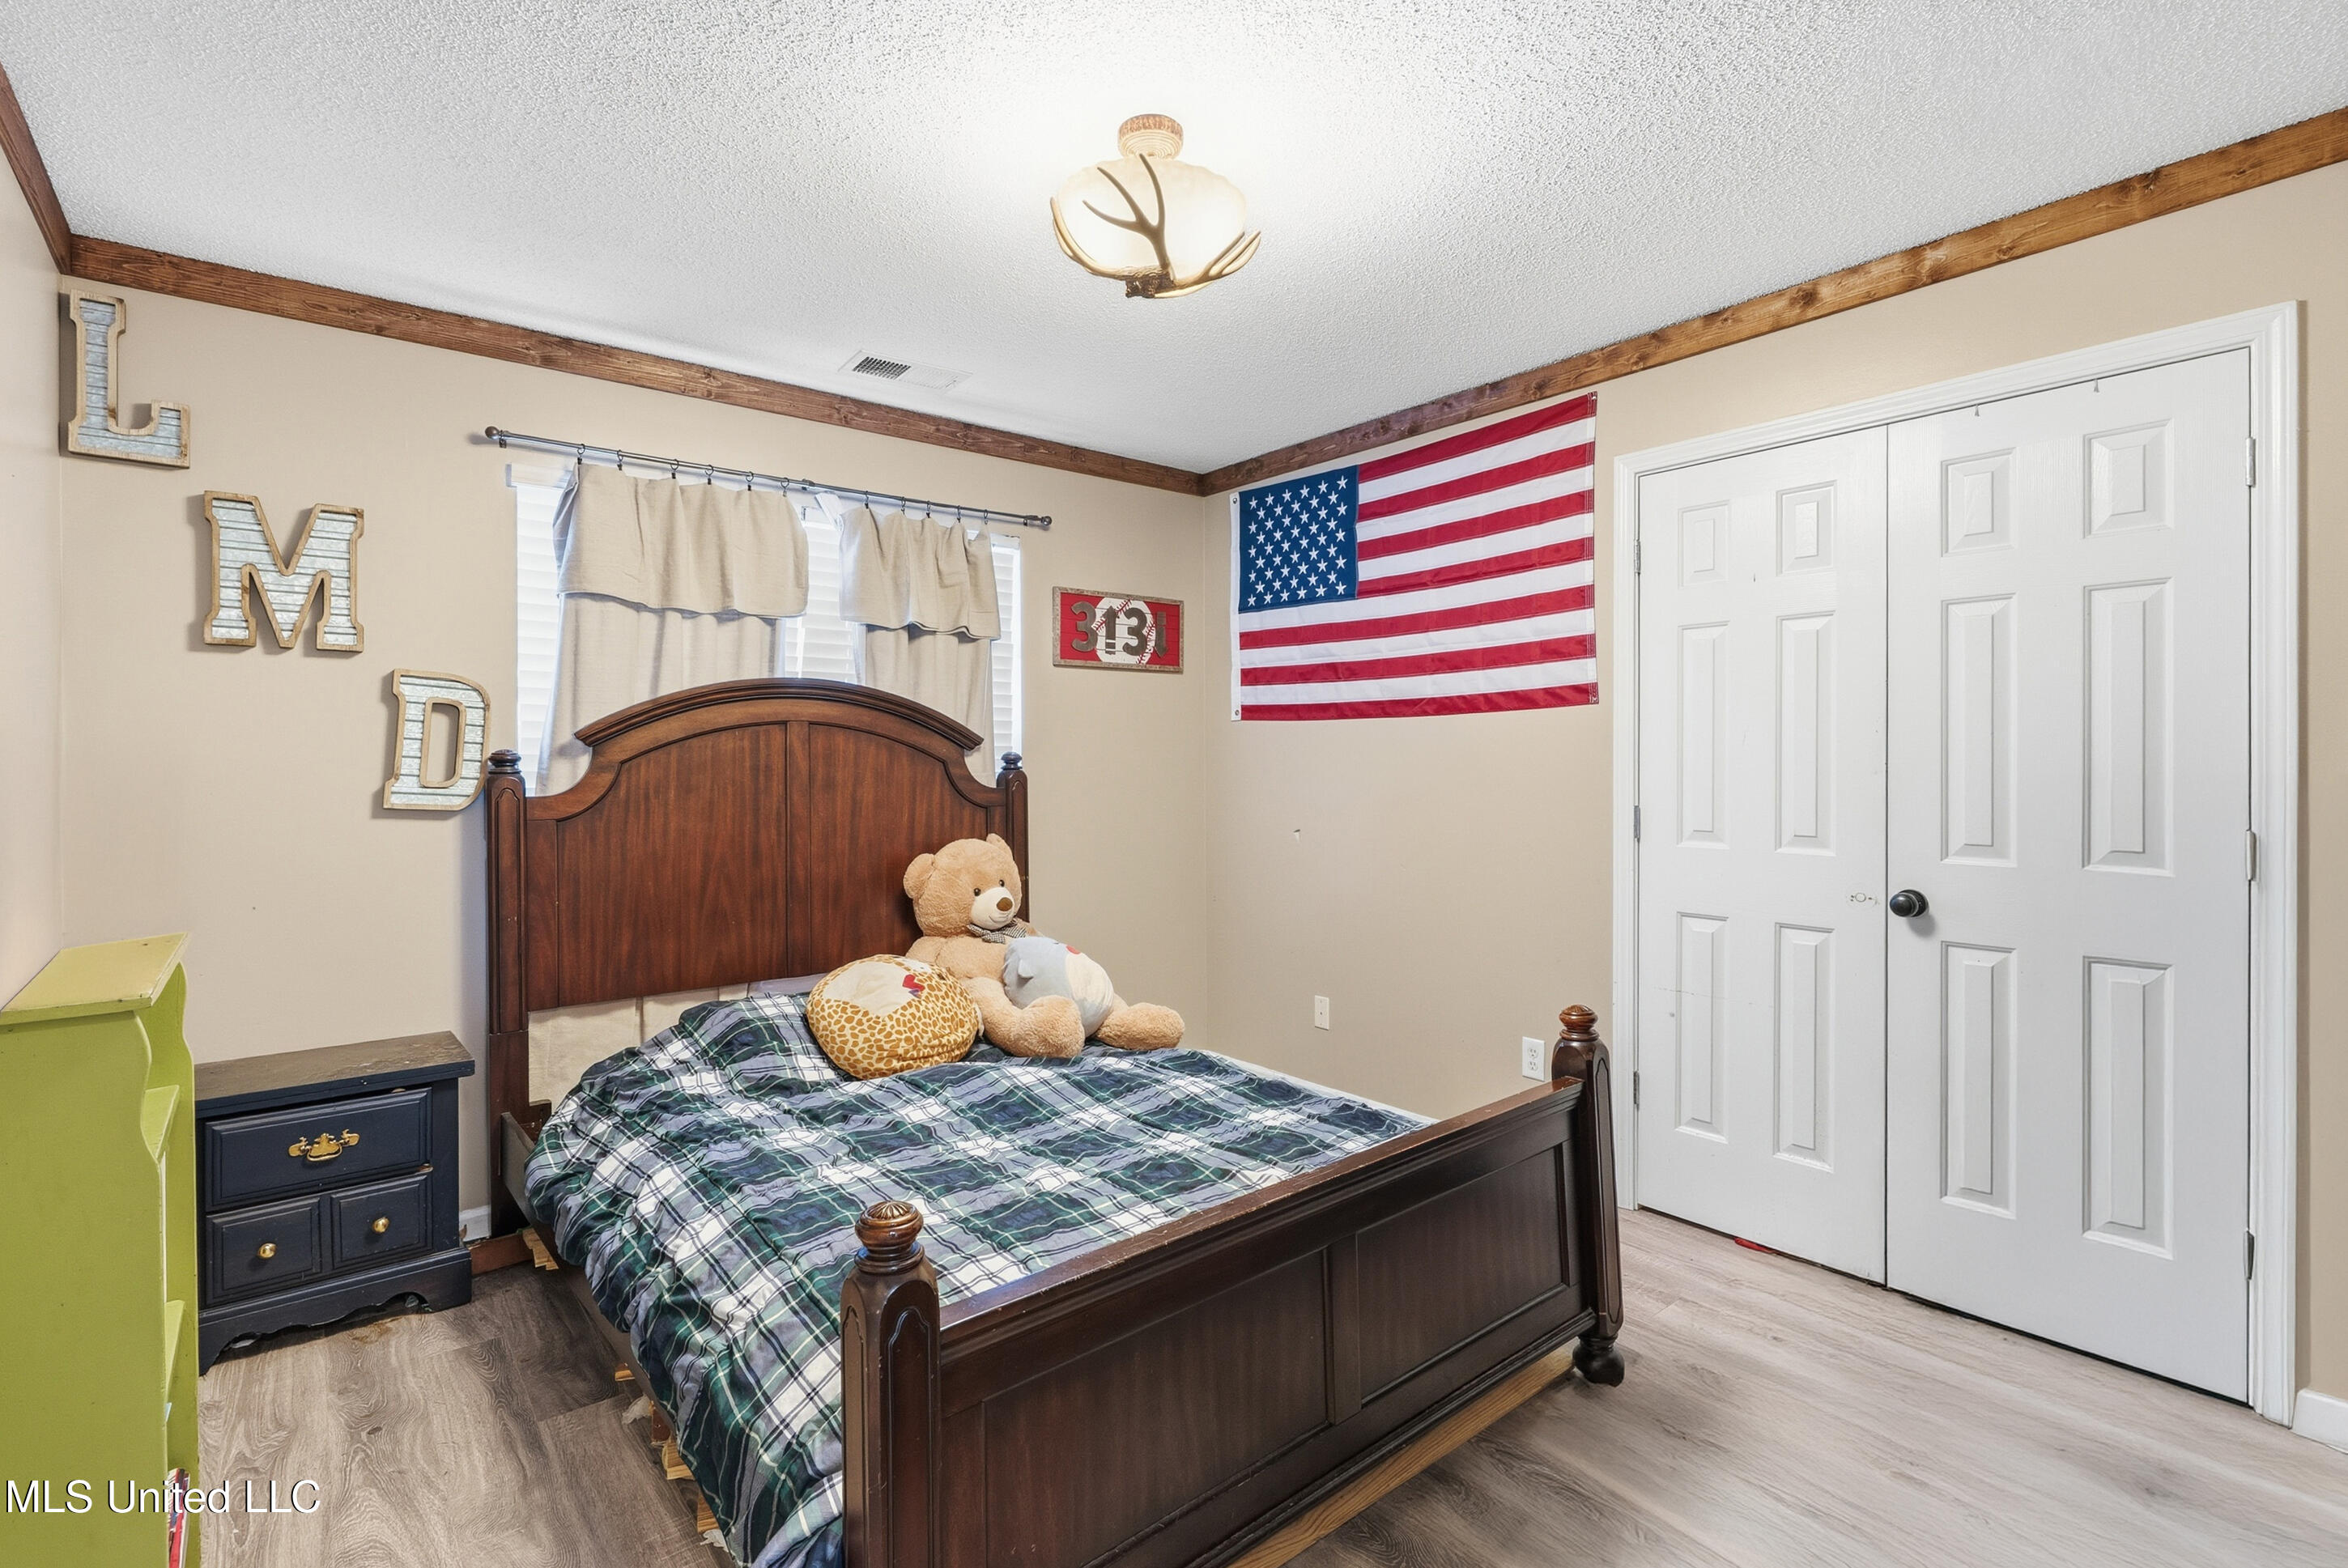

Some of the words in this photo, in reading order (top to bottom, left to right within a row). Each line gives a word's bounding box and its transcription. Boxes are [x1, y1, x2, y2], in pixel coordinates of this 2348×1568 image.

[68, 289, 190, 468] L
[204, 490, 364, 652] M
[383, 668, 491, 810] D
